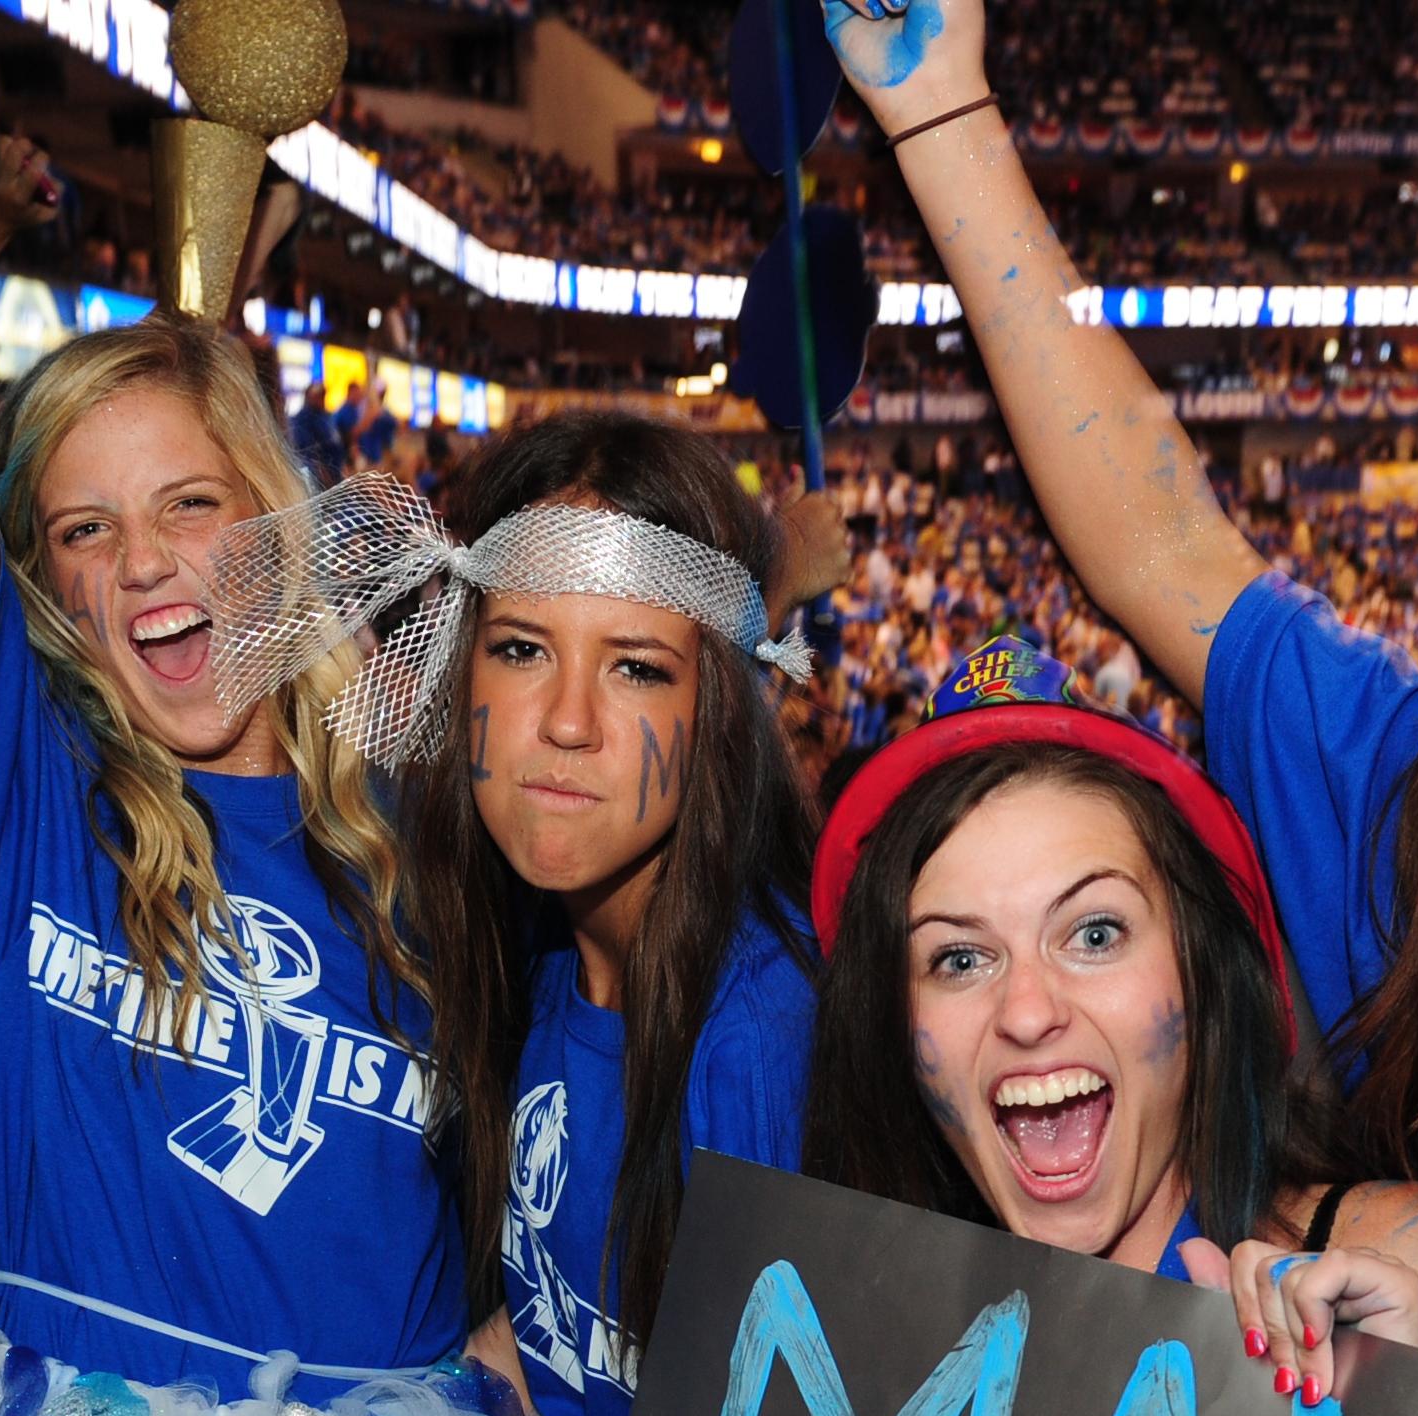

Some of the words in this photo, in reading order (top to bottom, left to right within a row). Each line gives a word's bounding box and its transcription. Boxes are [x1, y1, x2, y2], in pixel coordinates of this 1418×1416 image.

[953, 663, 1046, 694] CHIEF
[968, 649, 1038, 675] FIRE
[28, 912, 105, 1011] THE
[327, 1036, 388, 1106] IS
